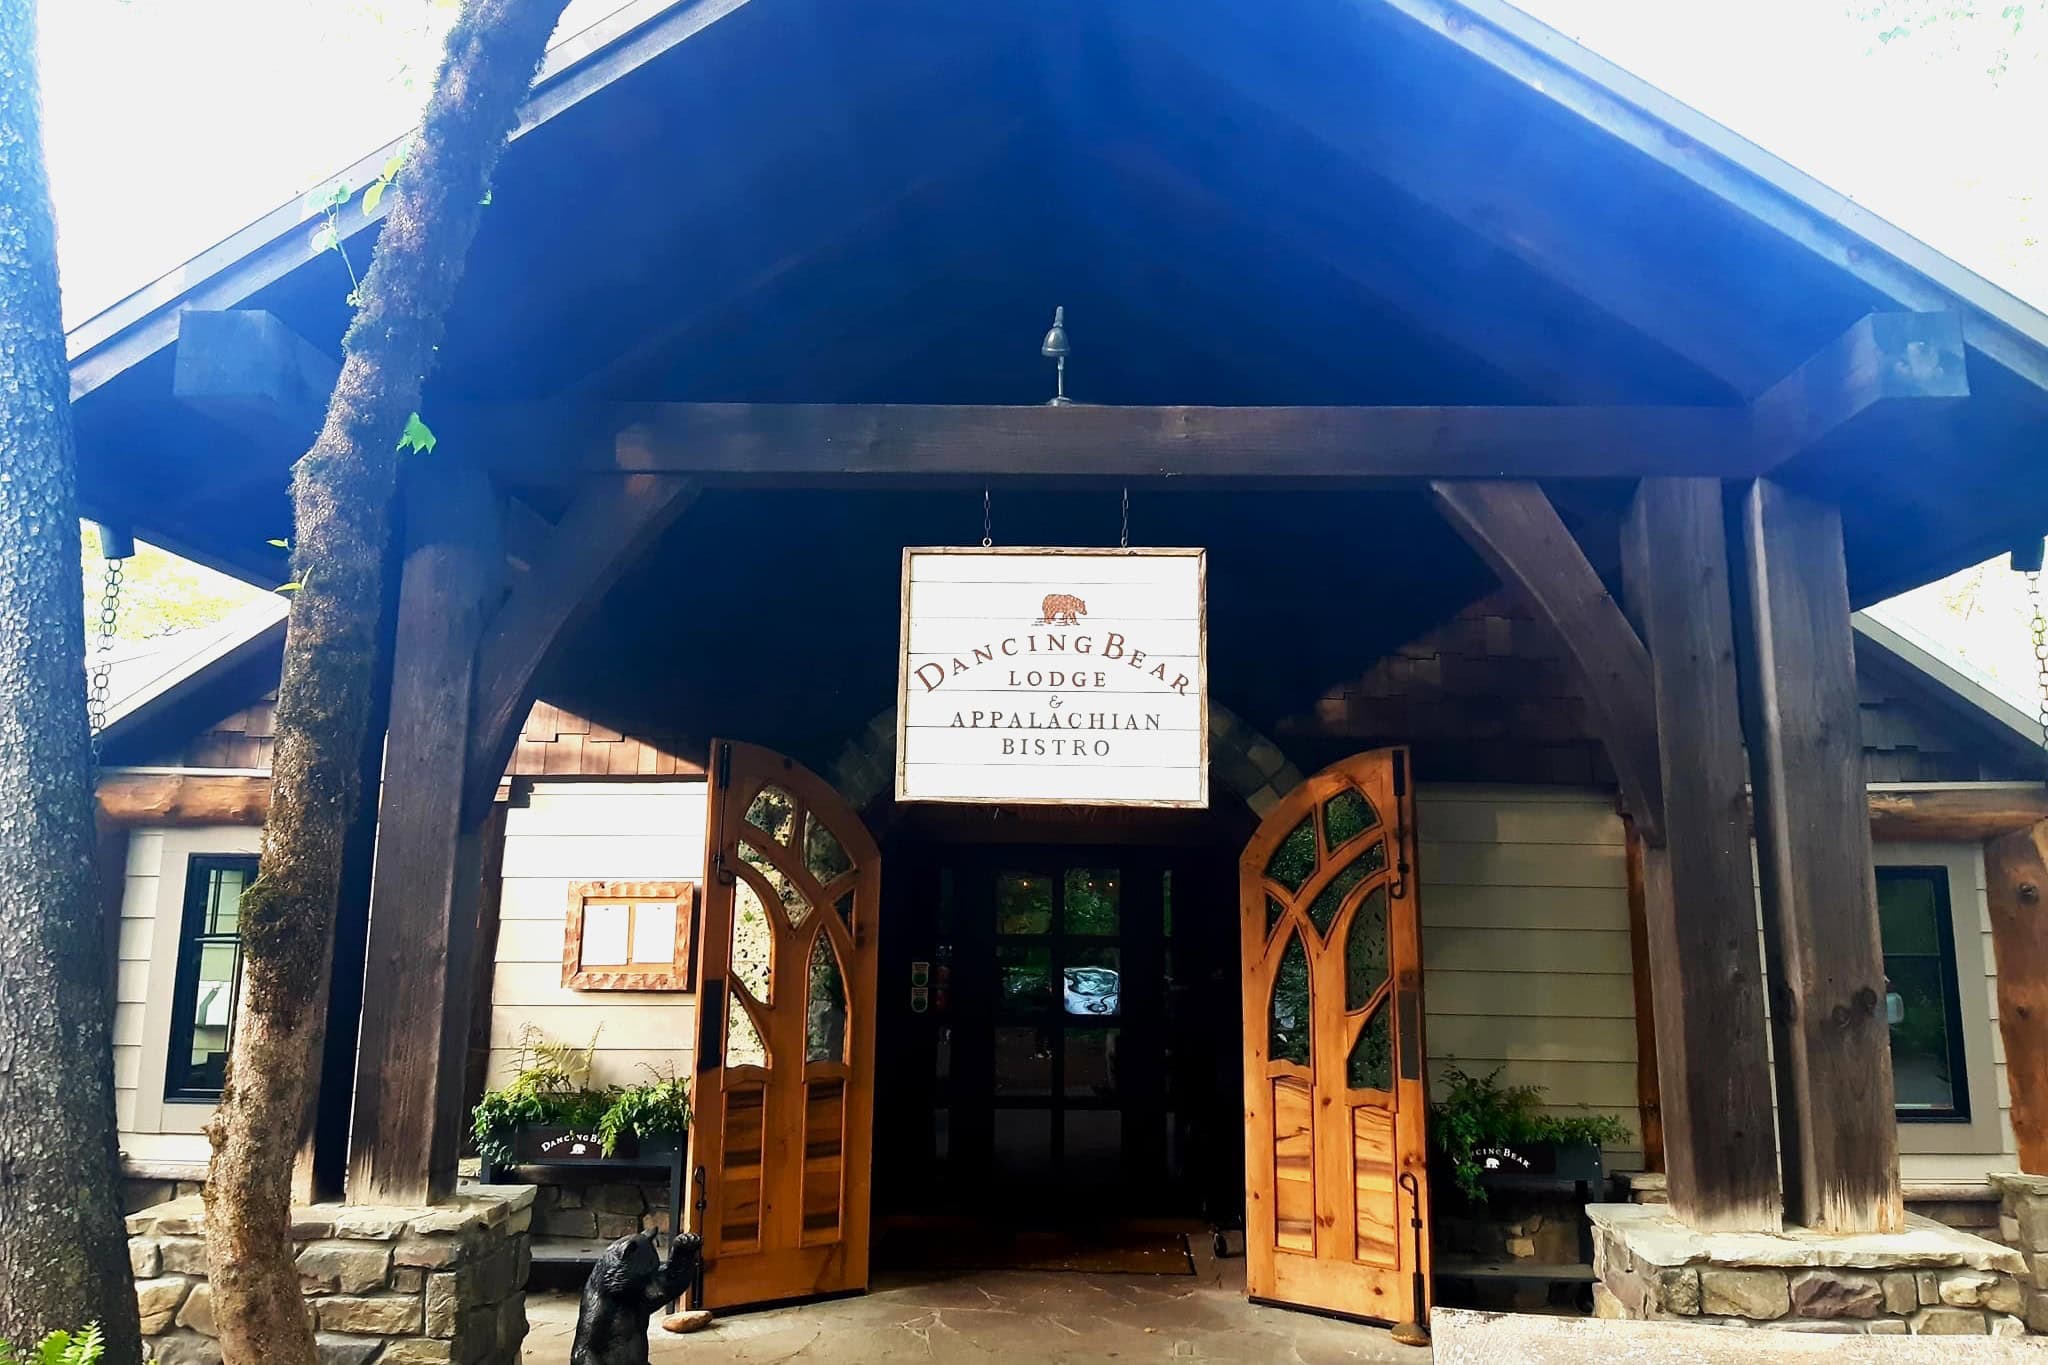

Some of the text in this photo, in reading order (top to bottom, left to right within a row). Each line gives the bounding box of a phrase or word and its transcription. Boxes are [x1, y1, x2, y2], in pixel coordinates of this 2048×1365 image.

[1008, 671, 1107, 688] LODGE
[1049, 695, 1064, 709] &
[950, 711, 1161, 731] APPALACHIAN
[1002, 738, 1110, 757] BISTRO
